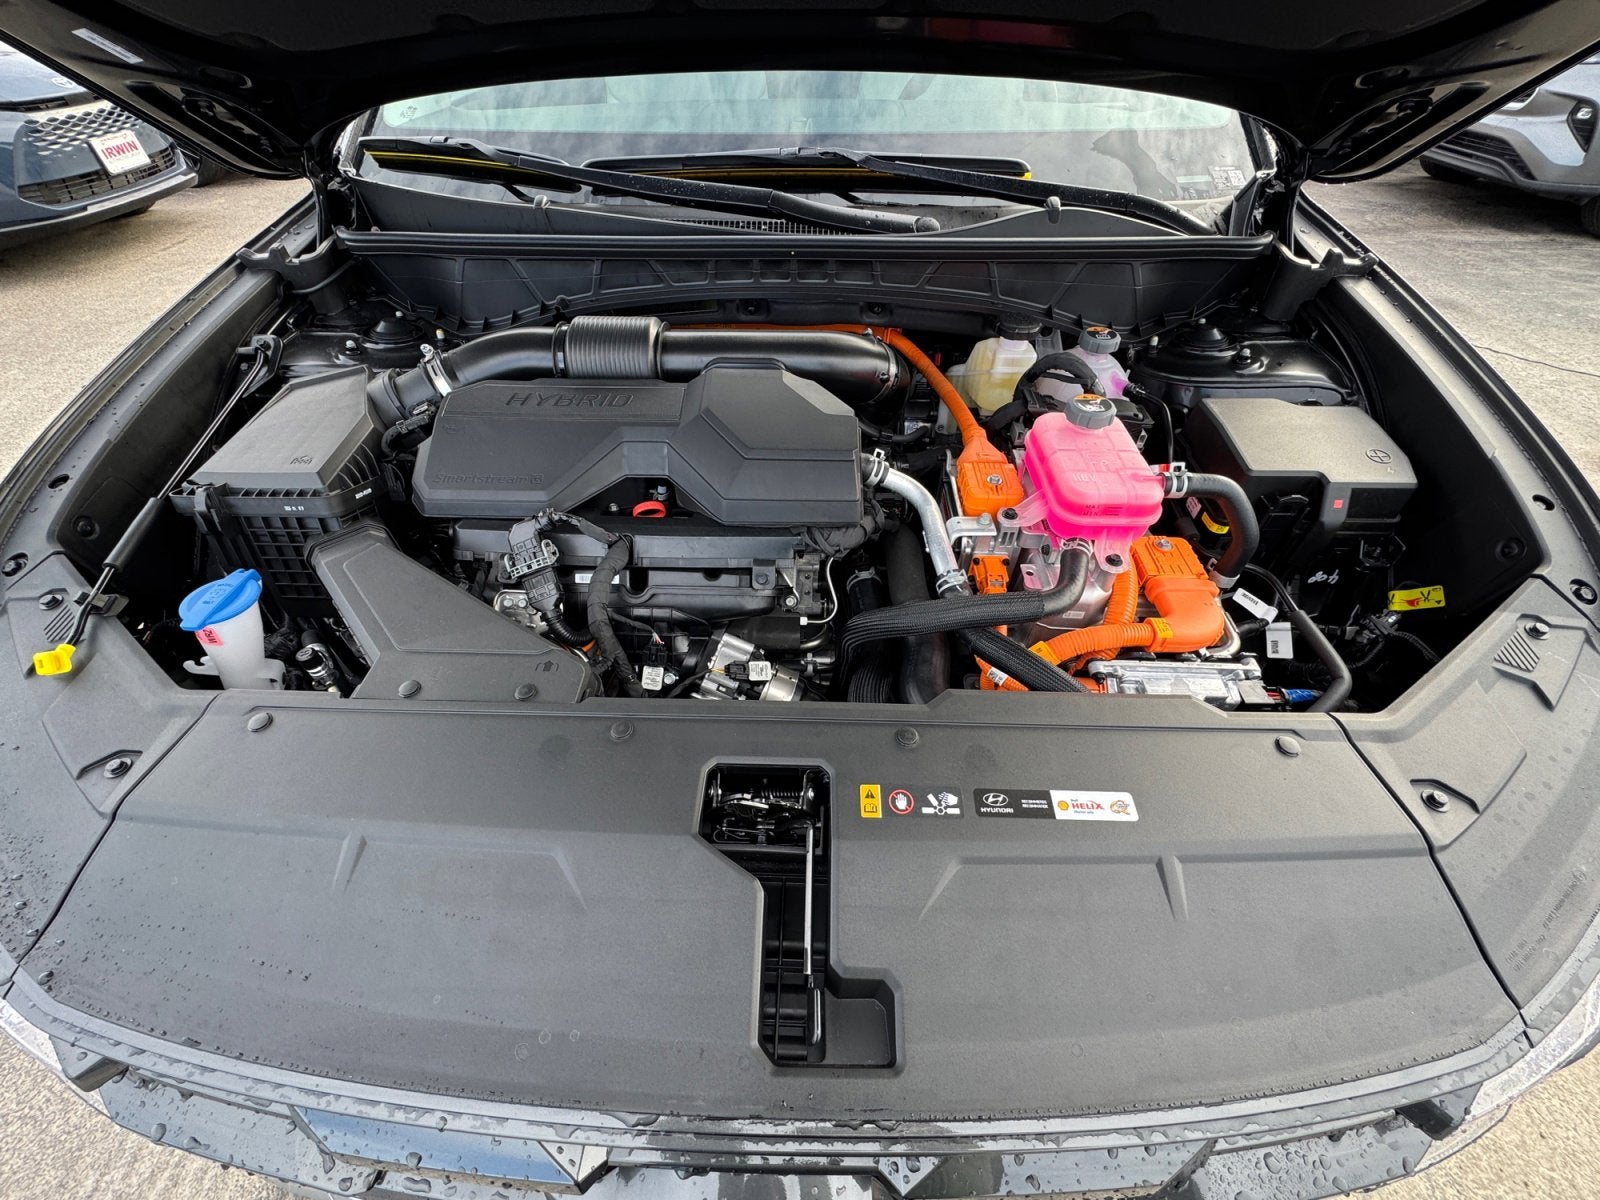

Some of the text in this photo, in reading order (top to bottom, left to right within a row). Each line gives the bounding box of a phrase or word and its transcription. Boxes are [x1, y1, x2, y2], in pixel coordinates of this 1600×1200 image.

[101, 140, 139, 160] IRWIN
[505, 392, 634, 407] HYBRID
[1071, 802, 1105, 810] HELIX
